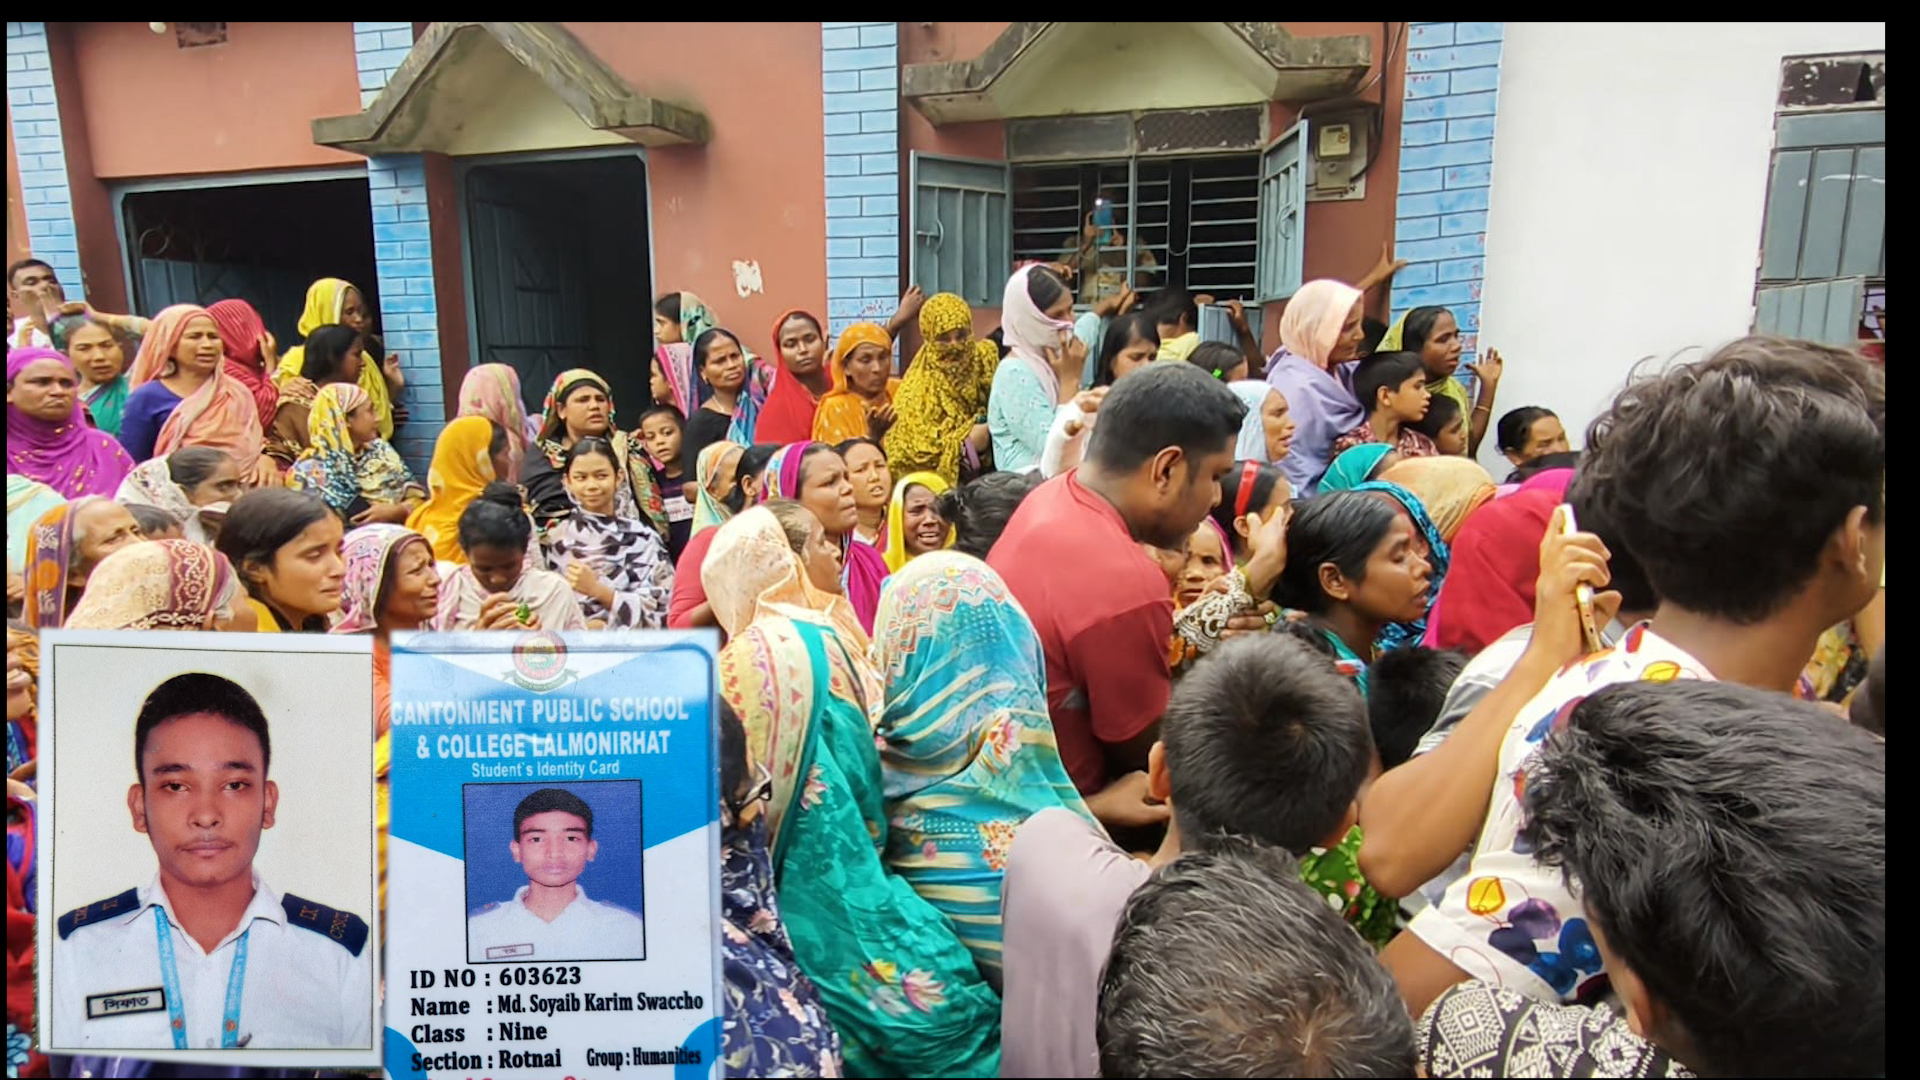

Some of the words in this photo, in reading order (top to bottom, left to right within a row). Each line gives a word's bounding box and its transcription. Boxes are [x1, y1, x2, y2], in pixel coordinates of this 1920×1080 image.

[391, 699, 525, 725] CANTONMENT
[532, 698, 603, 723] PUBLIC
[609, 696, 689, 721] SCHOOL
[416, 735, 430, 758] &
[437, 733, 526, 758] COLLEGE
[532, 730, 671, 757] LALMONIRHAT
[537, 761, 585, 779] Identity
[589, 760, 620, 775] Card
[410, 970, 436, 988] ID
[444, 969, 476, 987] NO
[499, 967, 582, 986] 603623
[410, 998, 470, 1016] Name
[497, 995, 526, 1014] Md.
[529, 994, 581, 1017] Soyaib
[584, 993, 634, 1012] Karim
[637, 991, 704, 1010] Swaccho
[411, 1024, 466, 1043] Class
[499, 1022, 548, 1041] Nine
[411, 1052, 482, 1071] Section
[499, 1049, 562, 1068] Rotnai
[586, 1048, 624, 1069] Group
[632, 1047, 701, 1065] Humanities
